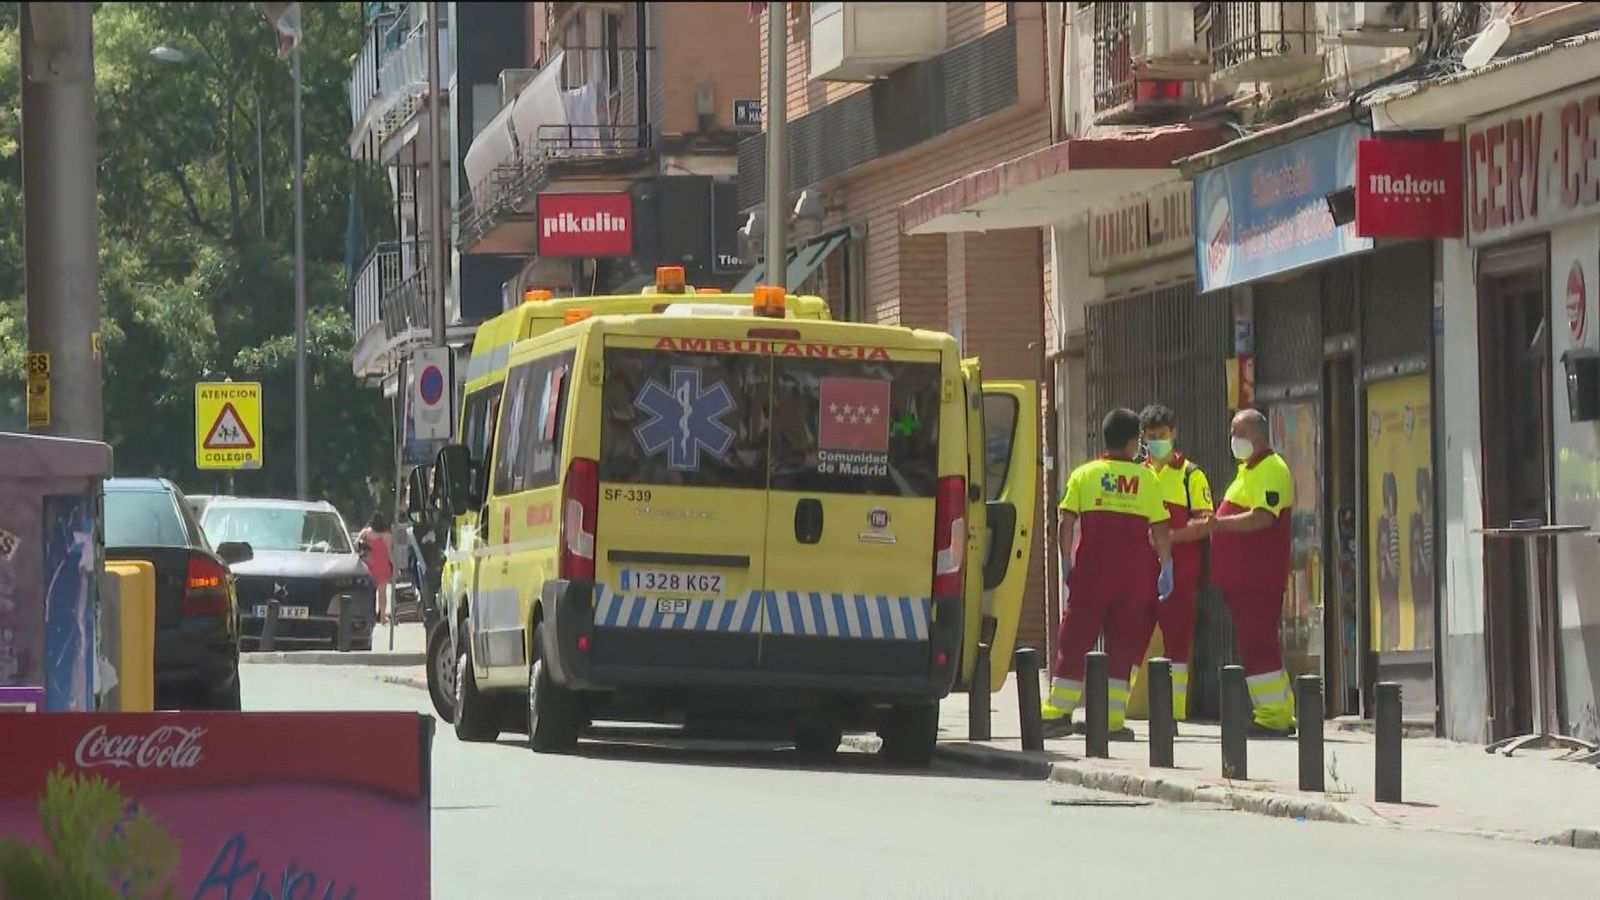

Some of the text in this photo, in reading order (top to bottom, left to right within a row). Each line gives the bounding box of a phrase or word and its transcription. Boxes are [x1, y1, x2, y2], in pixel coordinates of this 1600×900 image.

[1369, 174, 1446, 195] Mahou
[543, 211, 626, 238] pikolin
[655, 336, 891, 362] AMBULANCIA
[201, 390, 257, 399] ATENCION
[205, 453, 252, 462] COLEGIO
[817, 450, 889, 464] Comunidad
[817, 462, 888, 476] de Madrid
[604, 489, 652, 501] SF-339
[635, 572, 721, 593] 1328 KGZ
[660, 601, 685, 611] SP
[75, 725, 208, 768] Coca-Cola
